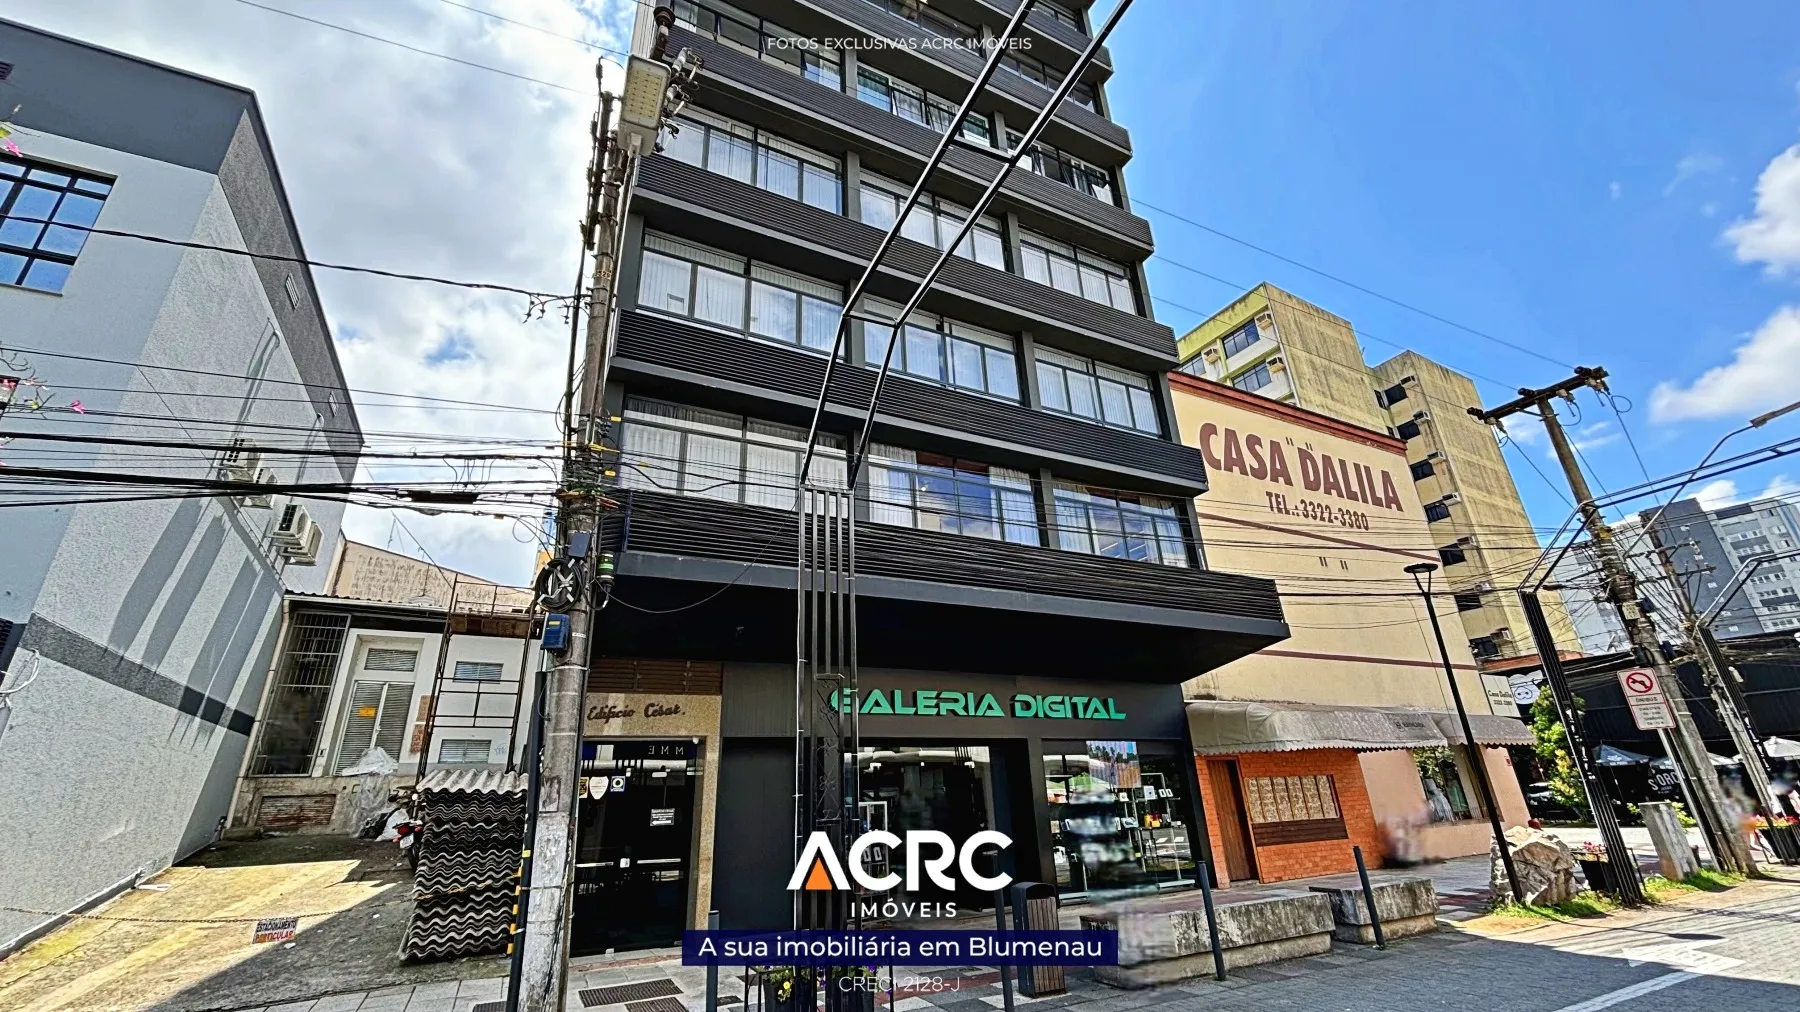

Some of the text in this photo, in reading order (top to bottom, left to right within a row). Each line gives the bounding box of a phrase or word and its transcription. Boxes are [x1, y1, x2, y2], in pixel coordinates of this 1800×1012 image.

[1199, 422, 1404, 513] CASA DALILA
[1299, 499, 1370, 531] 3322-3380
[830, 688, 1127, 720] GALERIA DIGITAL
